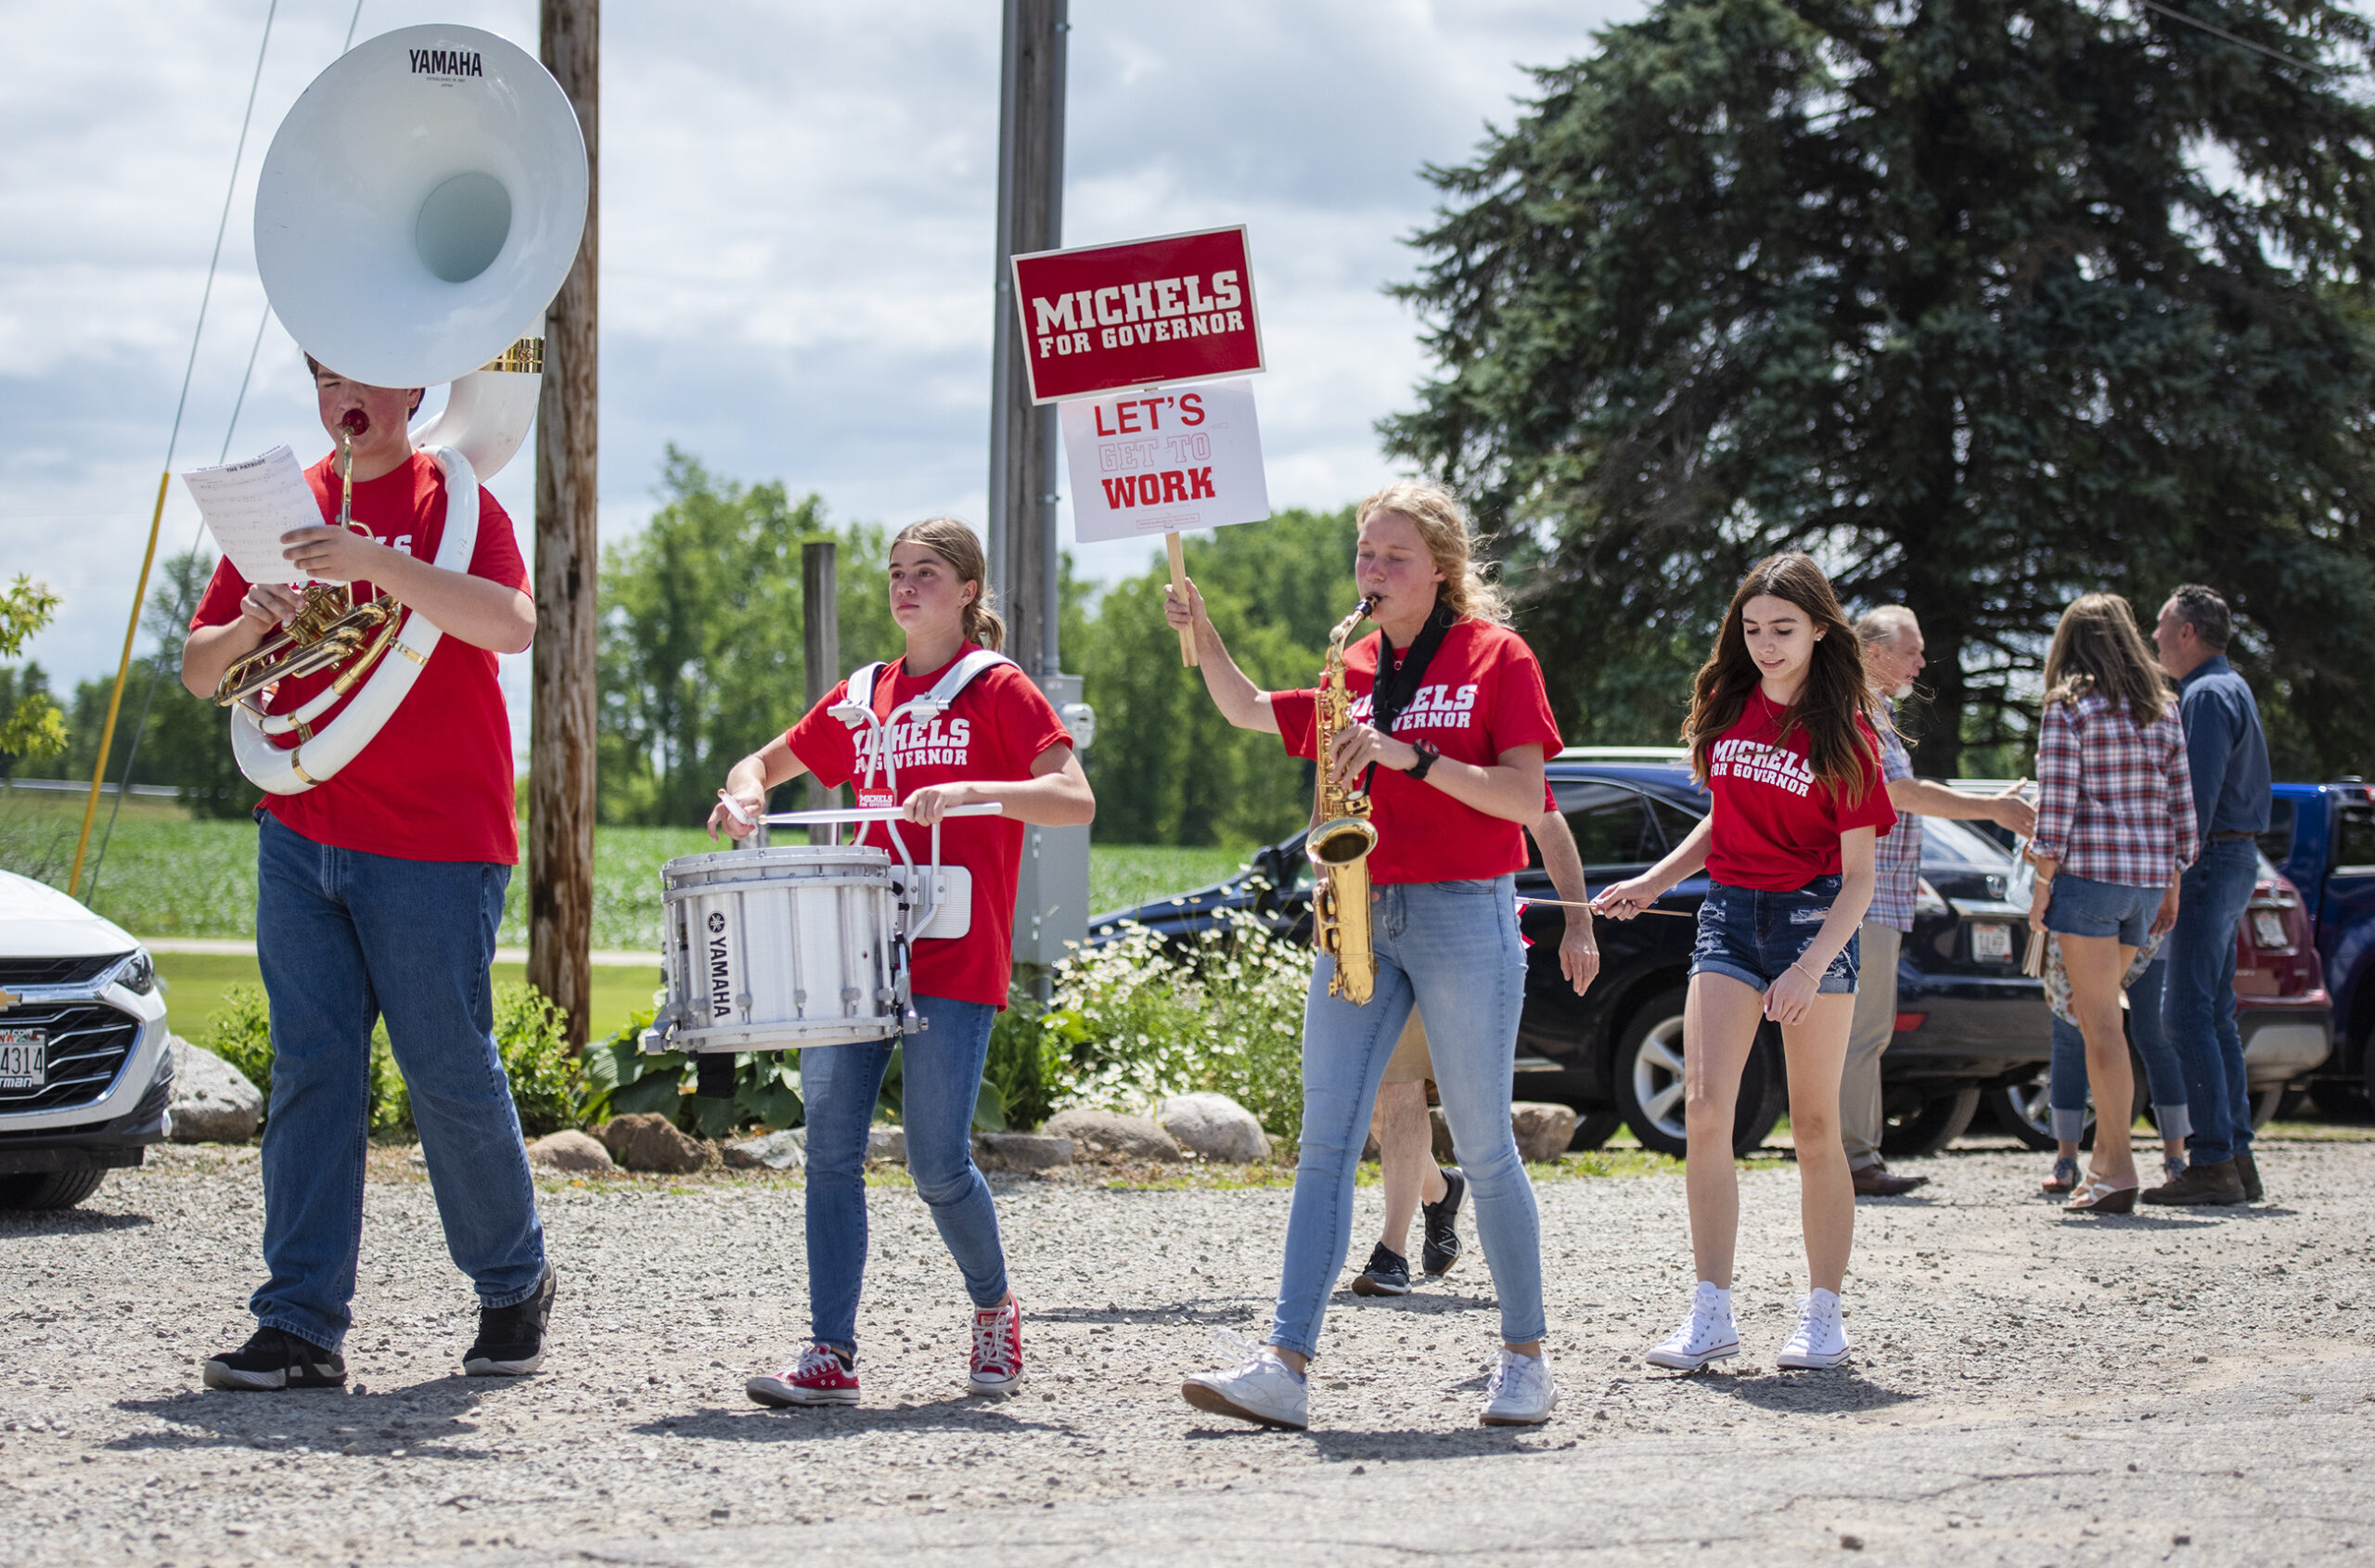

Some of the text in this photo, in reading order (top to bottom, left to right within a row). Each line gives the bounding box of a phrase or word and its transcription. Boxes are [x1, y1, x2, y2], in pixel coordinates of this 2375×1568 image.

[409, 49, 482, 77] YAMAHA
[1032, 270, 1242, 335] MICHELS
[1038, 311, 1245, 358] FOR GOVERNOR
[1094, 393, 1205, 437] LET'S
[239, 459, 266, 470] PATRIOT
[1098, 432, 1212, 472] GET TO
[1101, 467, 1216, 509] WORK
[875, 749, 968, 770] GVERNOR
[1712, 739, 1816, 784] MICHELS
[859, 794, 892, 803] MICHELS
[1733, 763, 1810, 797] GOVERNOR
[710, 936, 731, 1019] YAMAHA
[0, 1047, 43, 1074] 4314
